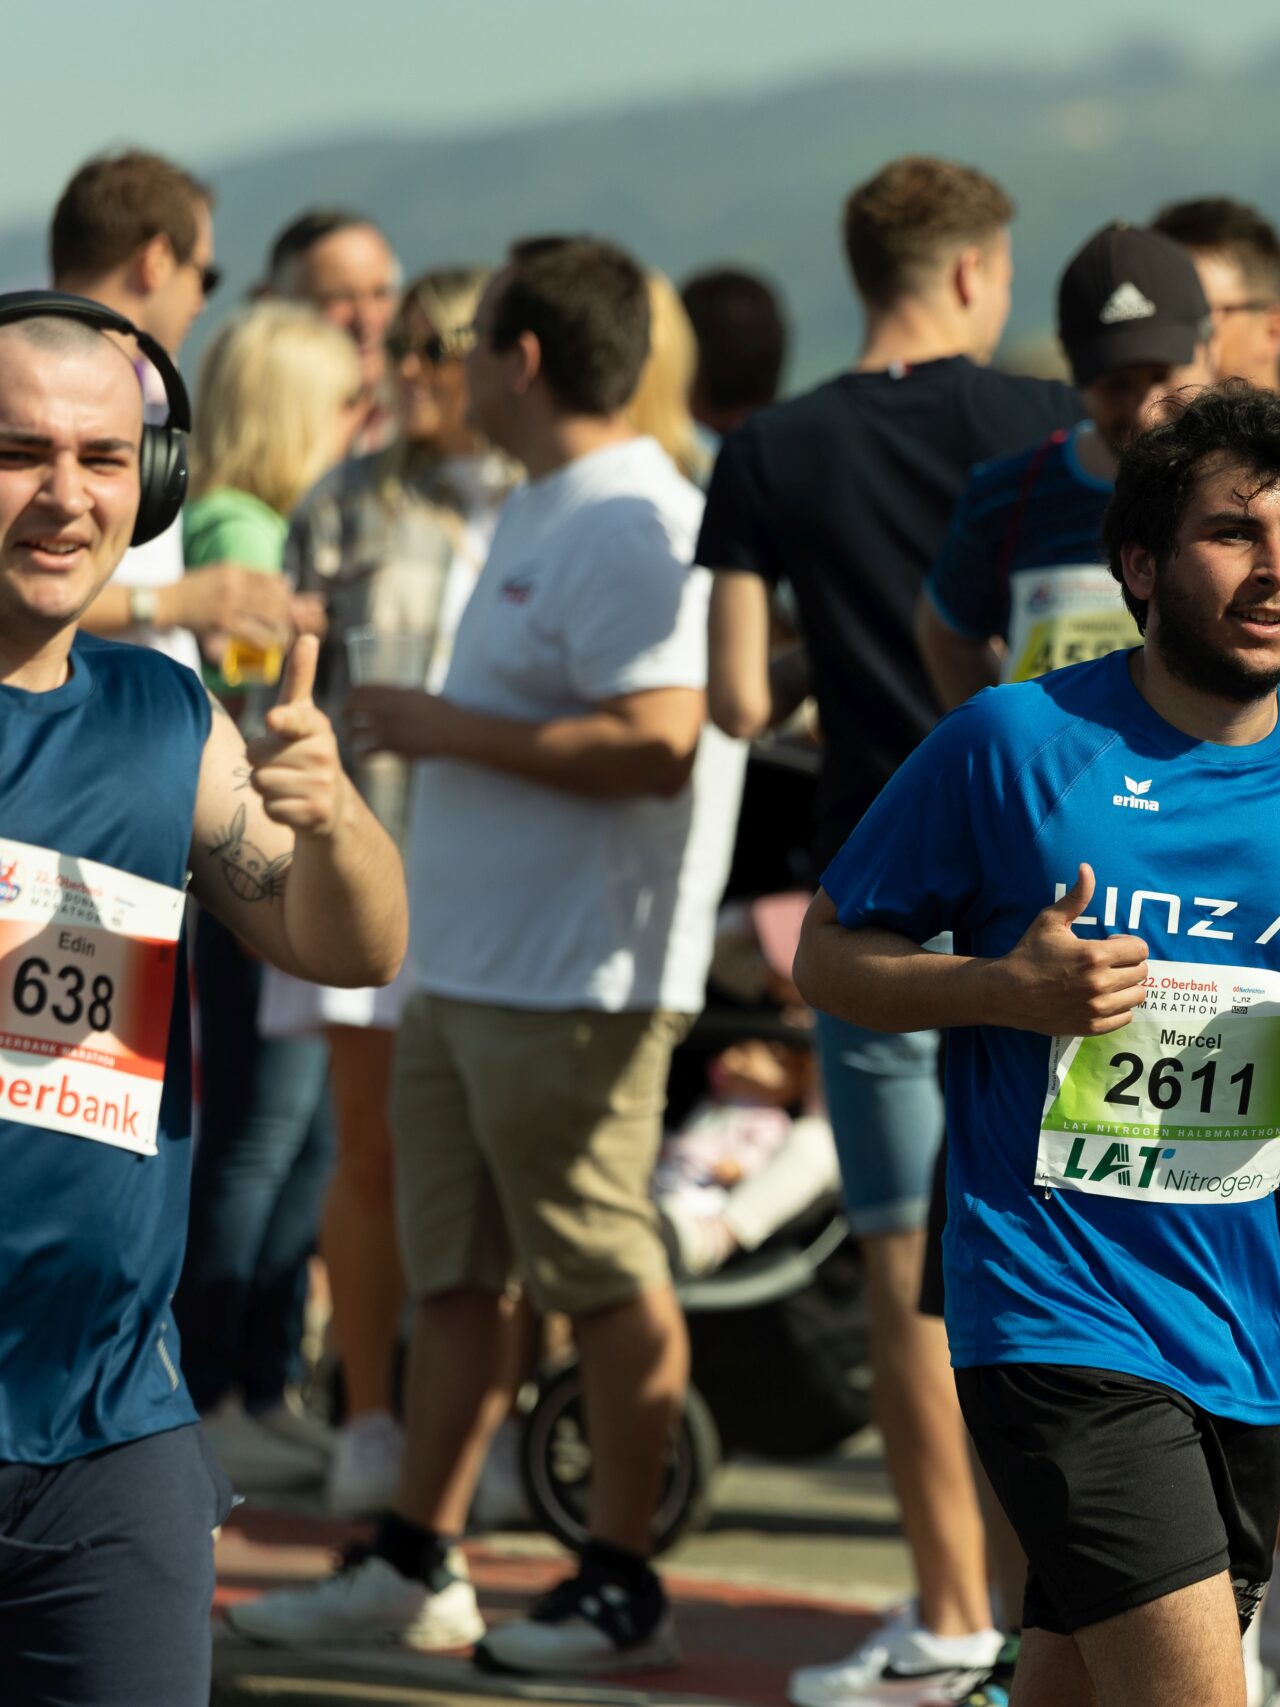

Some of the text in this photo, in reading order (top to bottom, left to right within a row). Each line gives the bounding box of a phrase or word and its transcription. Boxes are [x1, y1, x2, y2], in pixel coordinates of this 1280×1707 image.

[1112, 794, 1160, 812] erima
[58, 931, 96, 957] Edin
[13, 957, 114, 1032] 638
[1141, 977, 1218, 993] 22. Oberbank
[1146, 990, 1219, 1004] INZ DONAU
[1137, 1000, 1218, 1016] MARATHON
[1160, 1029, 1222, 1050] Marcel
[1103, 1051, 1256, 1117] 2611
[0, 1074, 140, 1138] erbank
[1062, 1121, 1089, 1132] LAT
[1096, 1124, 1171, 1138] NITROGEN
[1063, 1137, 1264, 1198] LAT Nitrogen
